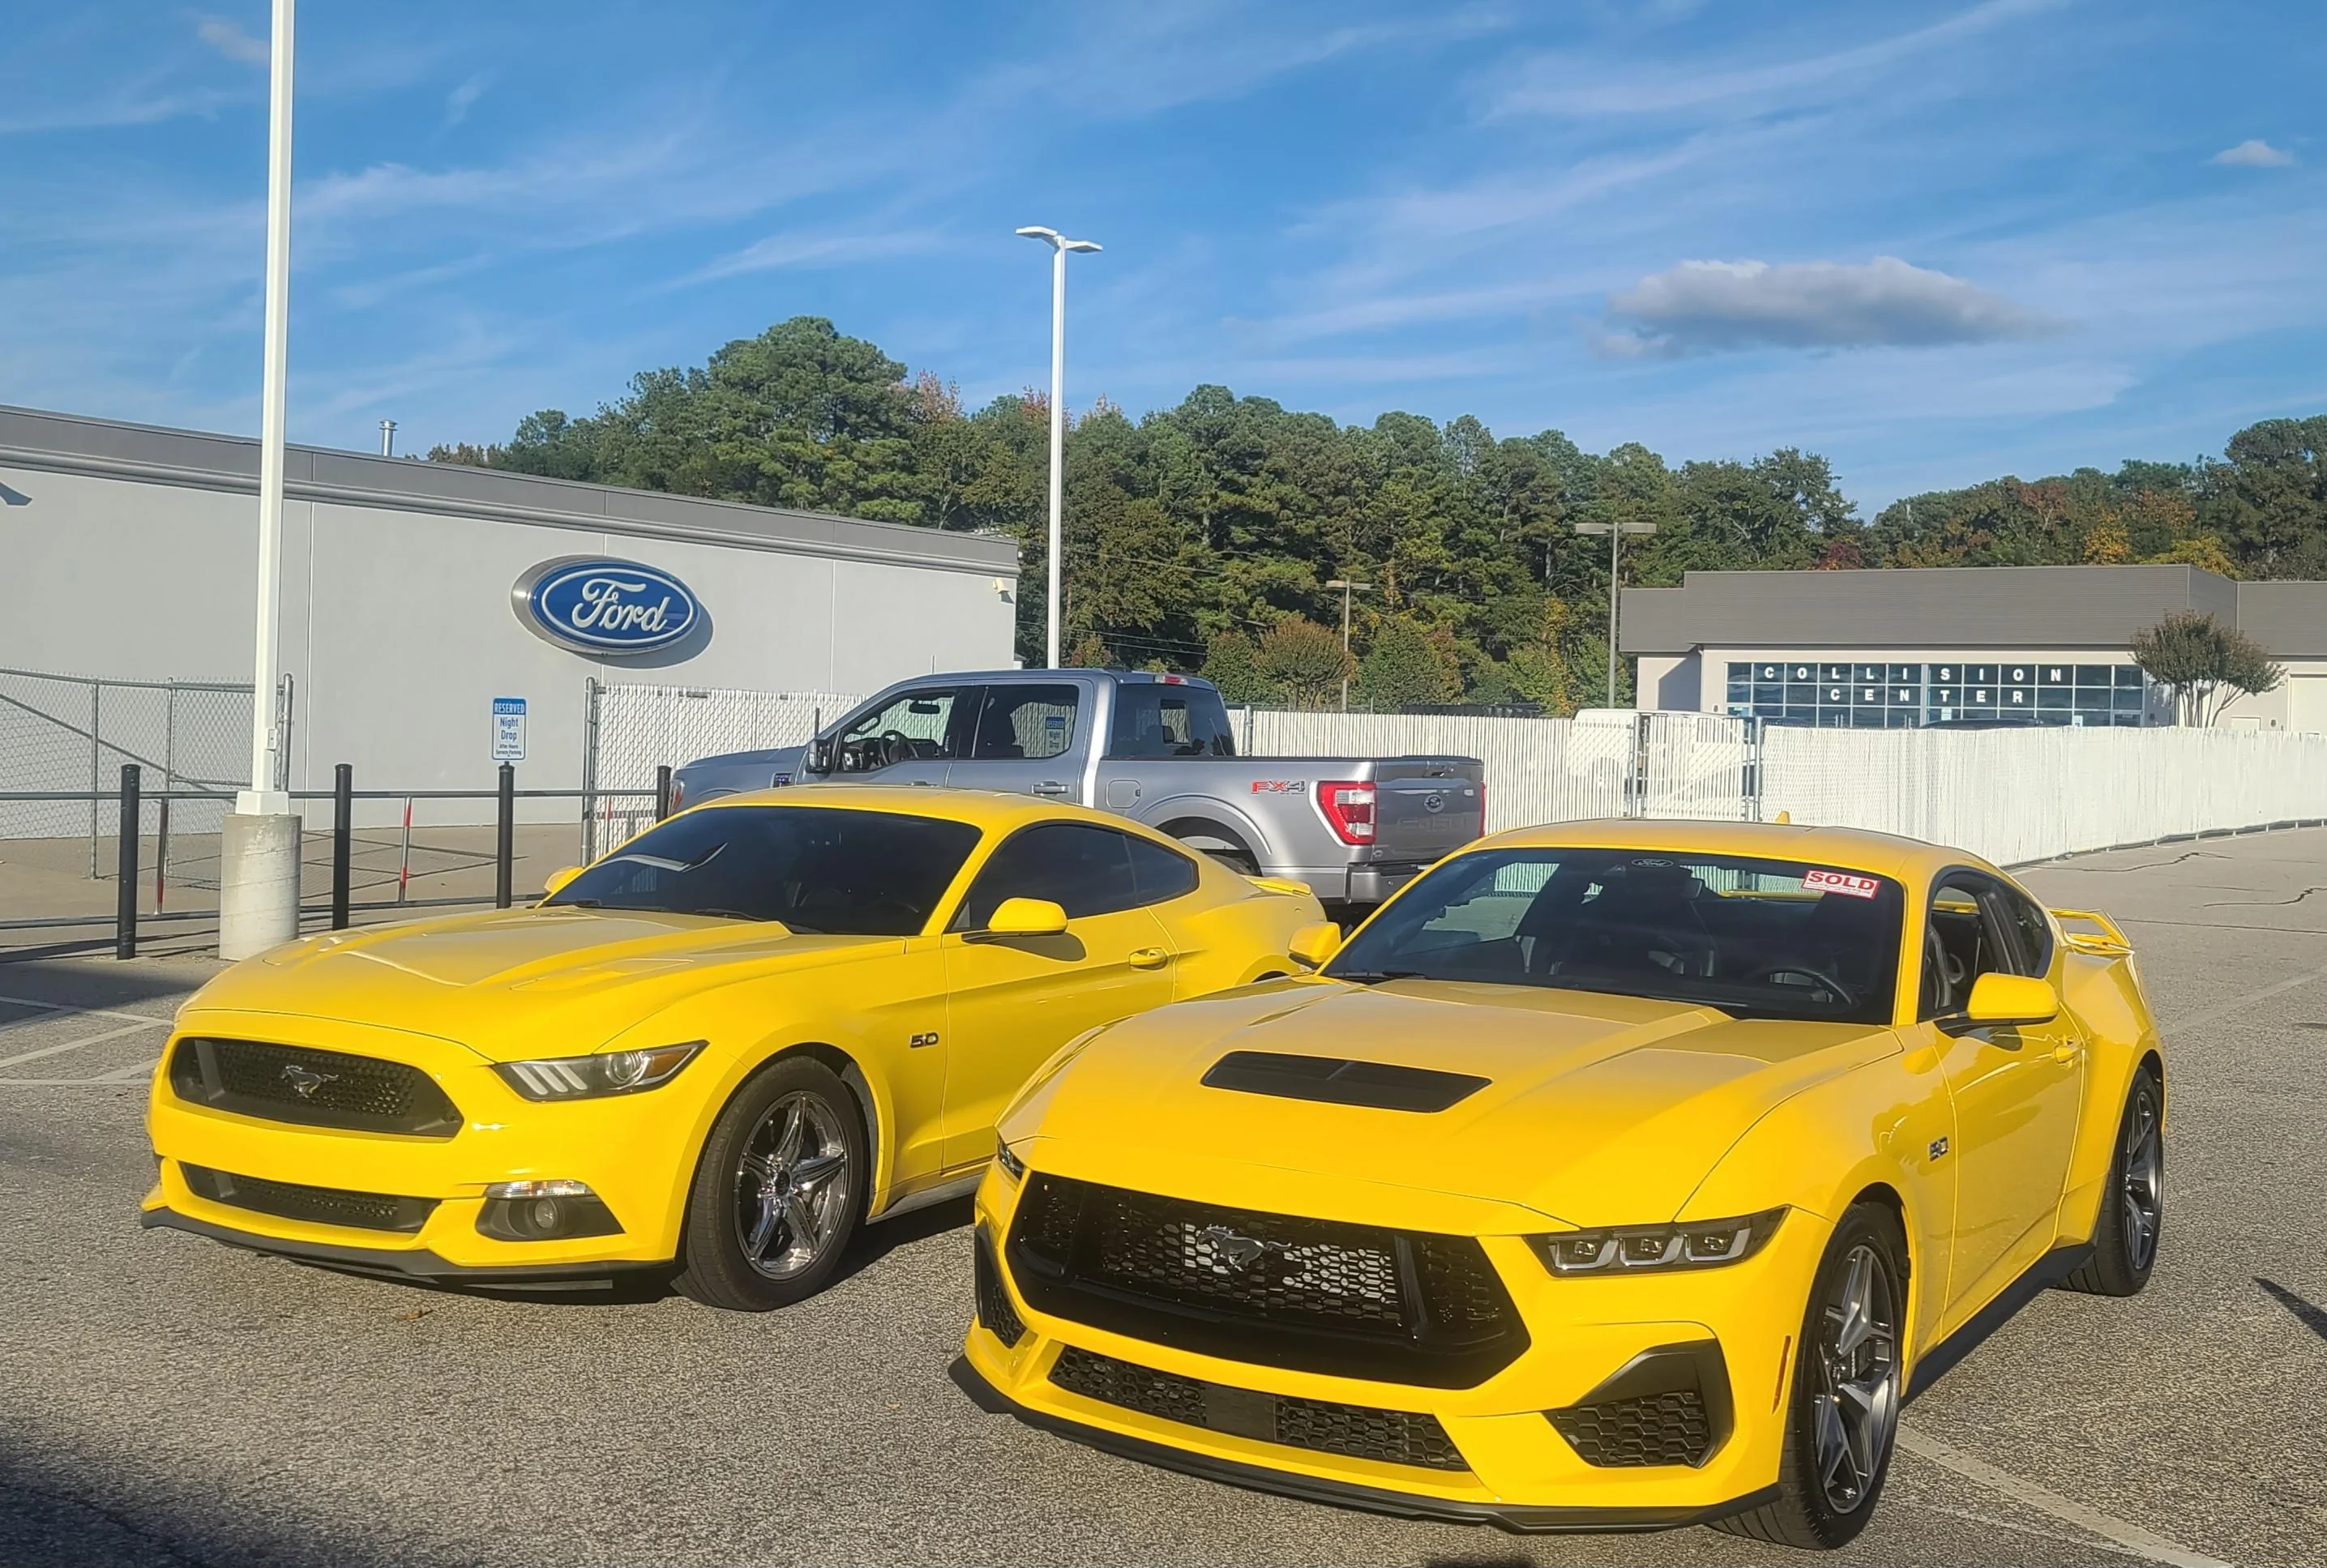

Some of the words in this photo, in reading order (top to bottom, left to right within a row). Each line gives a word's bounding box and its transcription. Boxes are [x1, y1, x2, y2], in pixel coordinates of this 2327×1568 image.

[571, 578, 671, 632] Ford
[1764, 666, 2061, 681] COLLISION
[1830, 689, 2023, 703] CENTER
[494, 703, 525, 714] RESERVED
[499, 716, 519, 728] Night
[501, 730, 517, 742] Drop
[1251, 780, 1305, 794] FX4
[1808, 872, 1875, 890] SOLD
